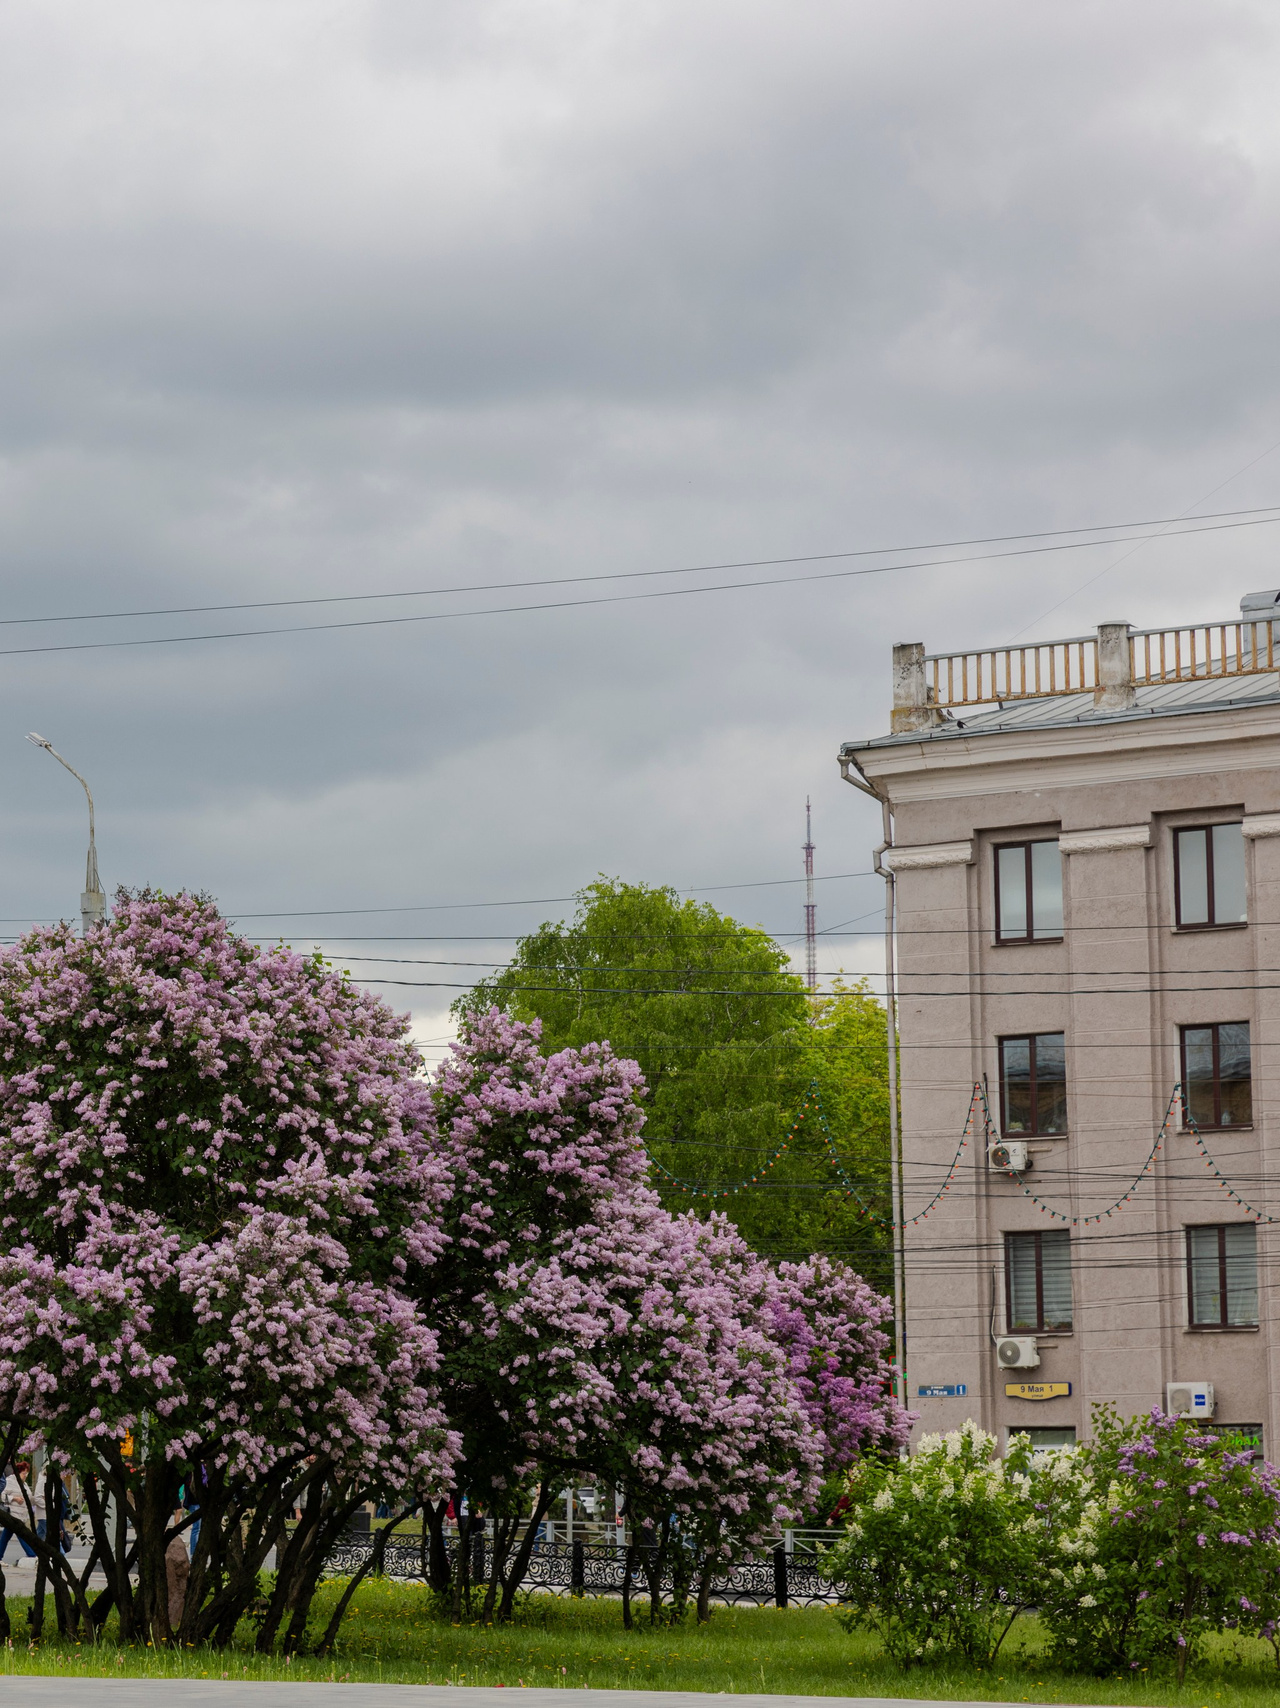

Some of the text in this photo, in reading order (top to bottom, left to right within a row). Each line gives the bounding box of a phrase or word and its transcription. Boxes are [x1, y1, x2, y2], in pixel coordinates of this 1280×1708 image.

[959, 1385, 963, 1395] 1
[1020, 1385, 1026, 1393] 9
[1027, 1385, 1044, 1393] Мая
